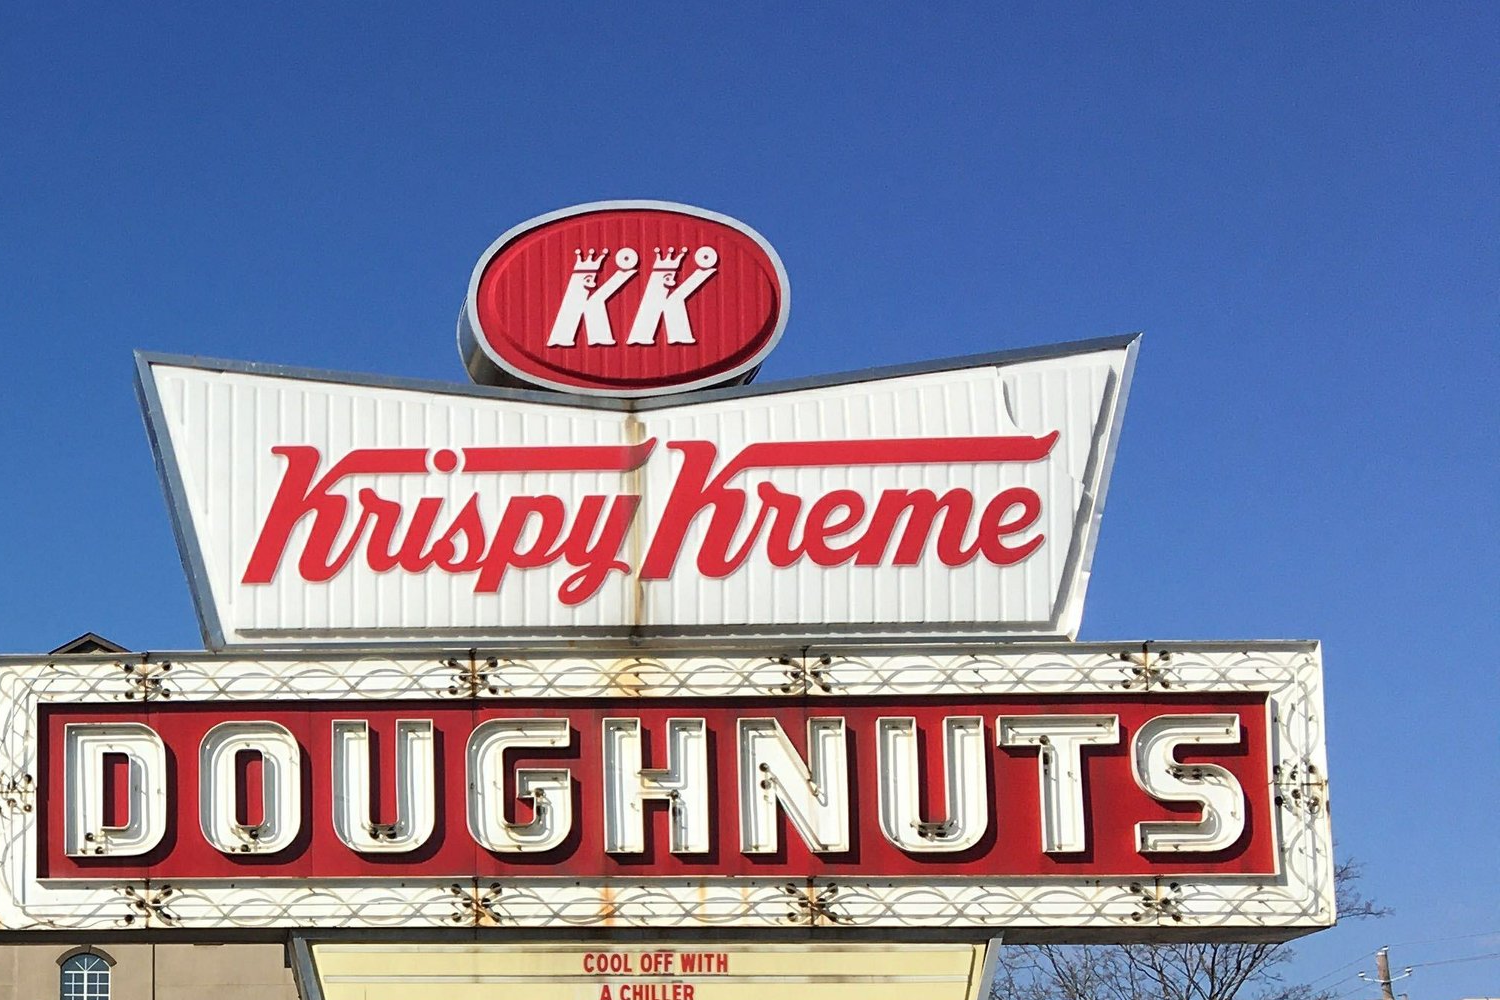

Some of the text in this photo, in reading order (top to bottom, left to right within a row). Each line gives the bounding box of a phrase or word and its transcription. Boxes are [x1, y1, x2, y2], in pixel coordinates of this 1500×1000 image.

[241, 430, 1059, 606] Krispy Kreme
[61, 713, 1247, 859] DOUGHNUTS
[583, 953, 728, 973] COOL OFF WITH
